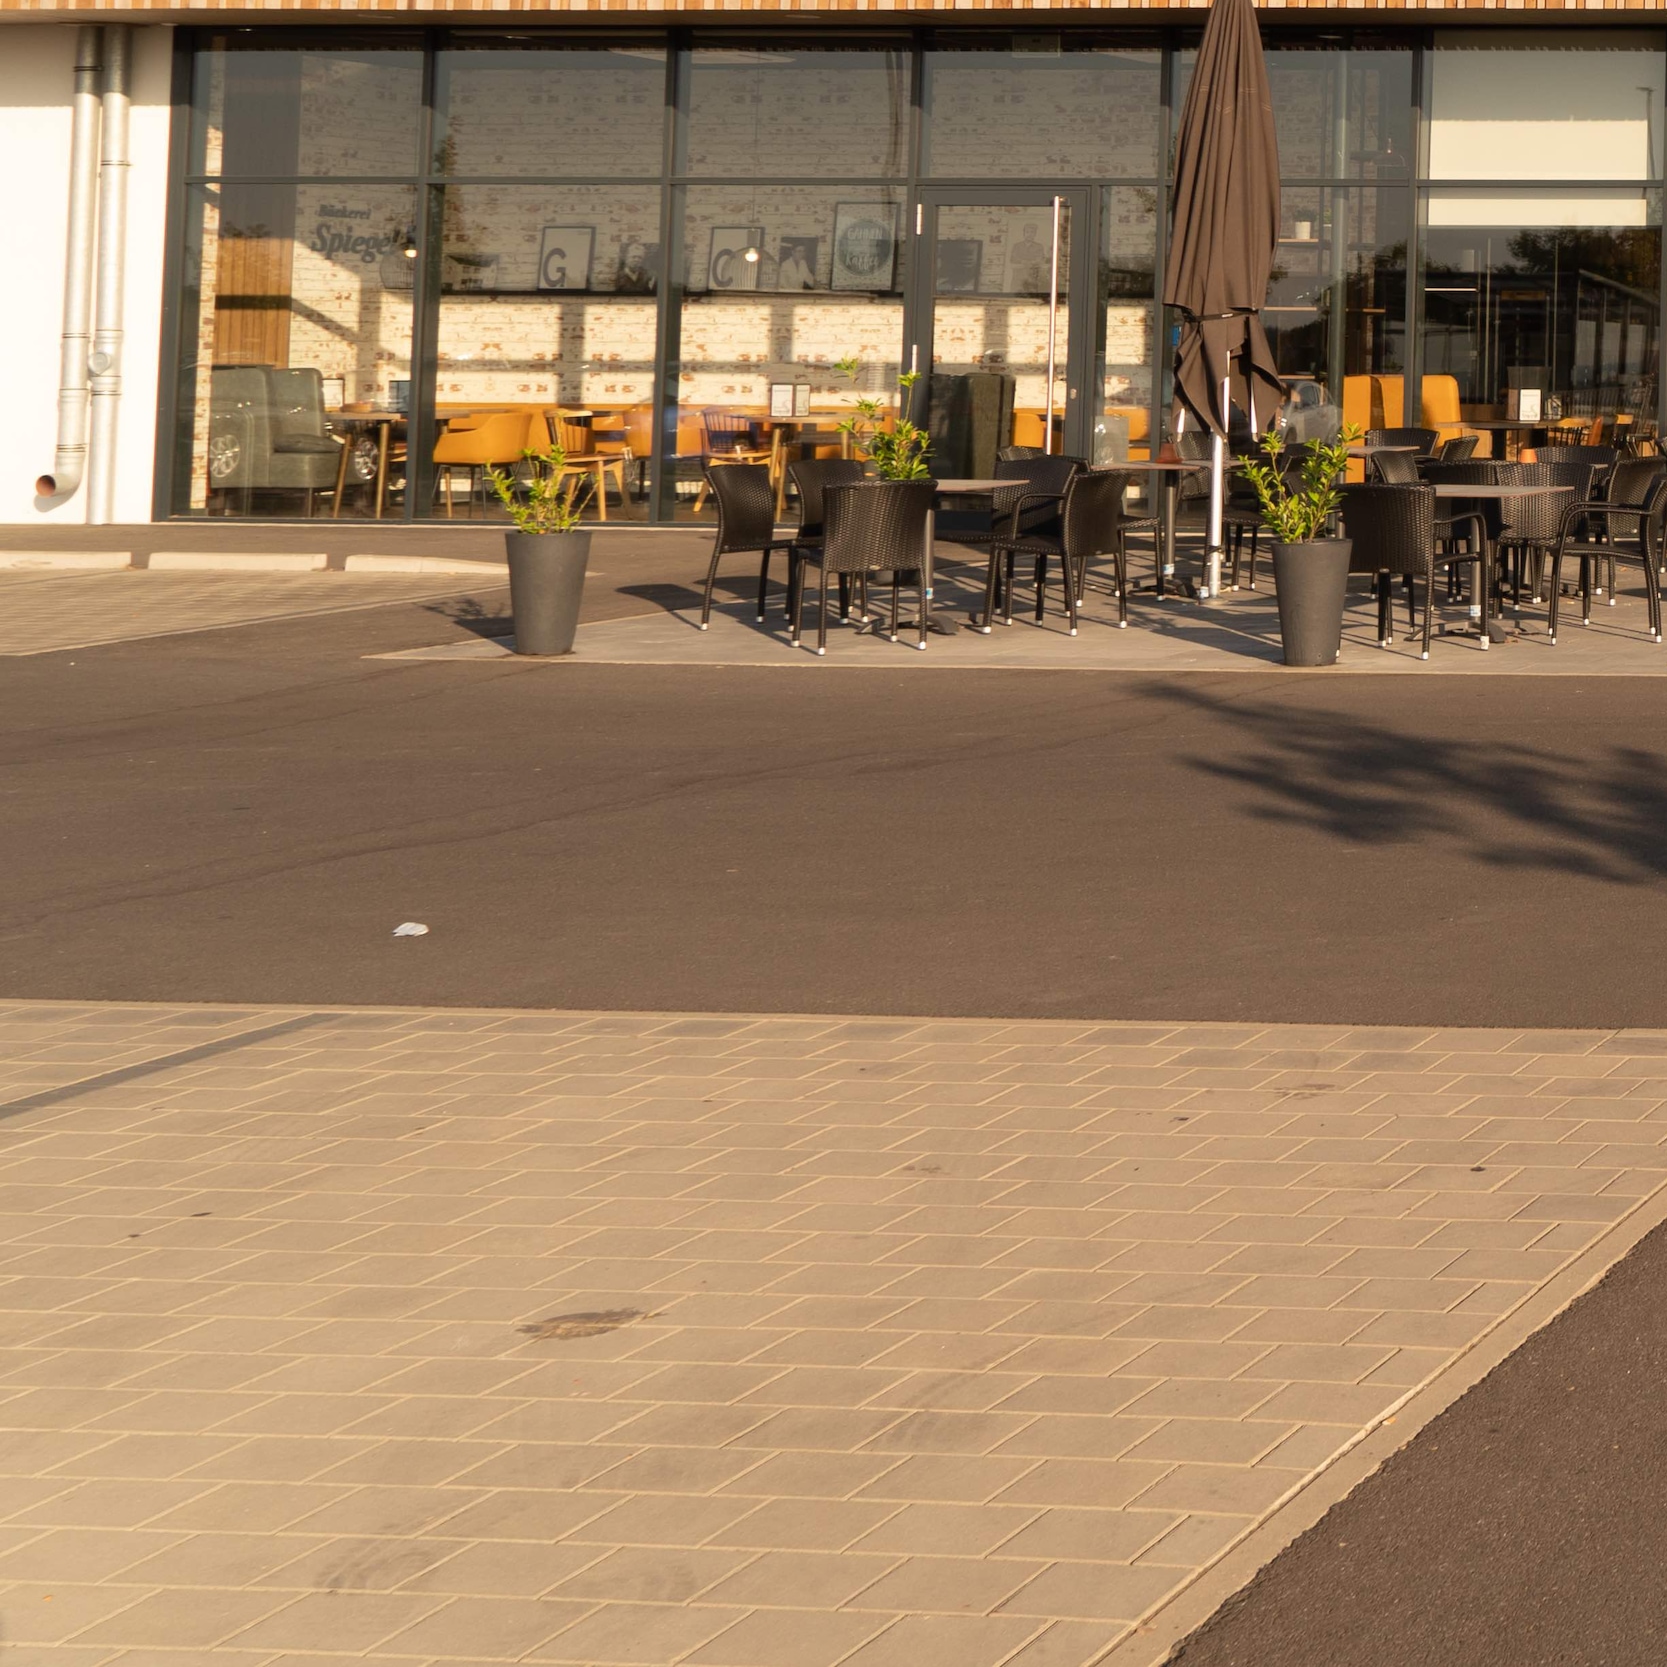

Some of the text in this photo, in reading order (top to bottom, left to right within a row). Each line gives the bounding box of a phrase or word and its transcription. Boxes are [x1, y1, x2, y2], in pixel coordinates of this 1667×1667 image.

[318, 204, 371, 220] Bäckerei
[311, 223, 401, 263] Spiegel
[543, 247, 567, 288] G
